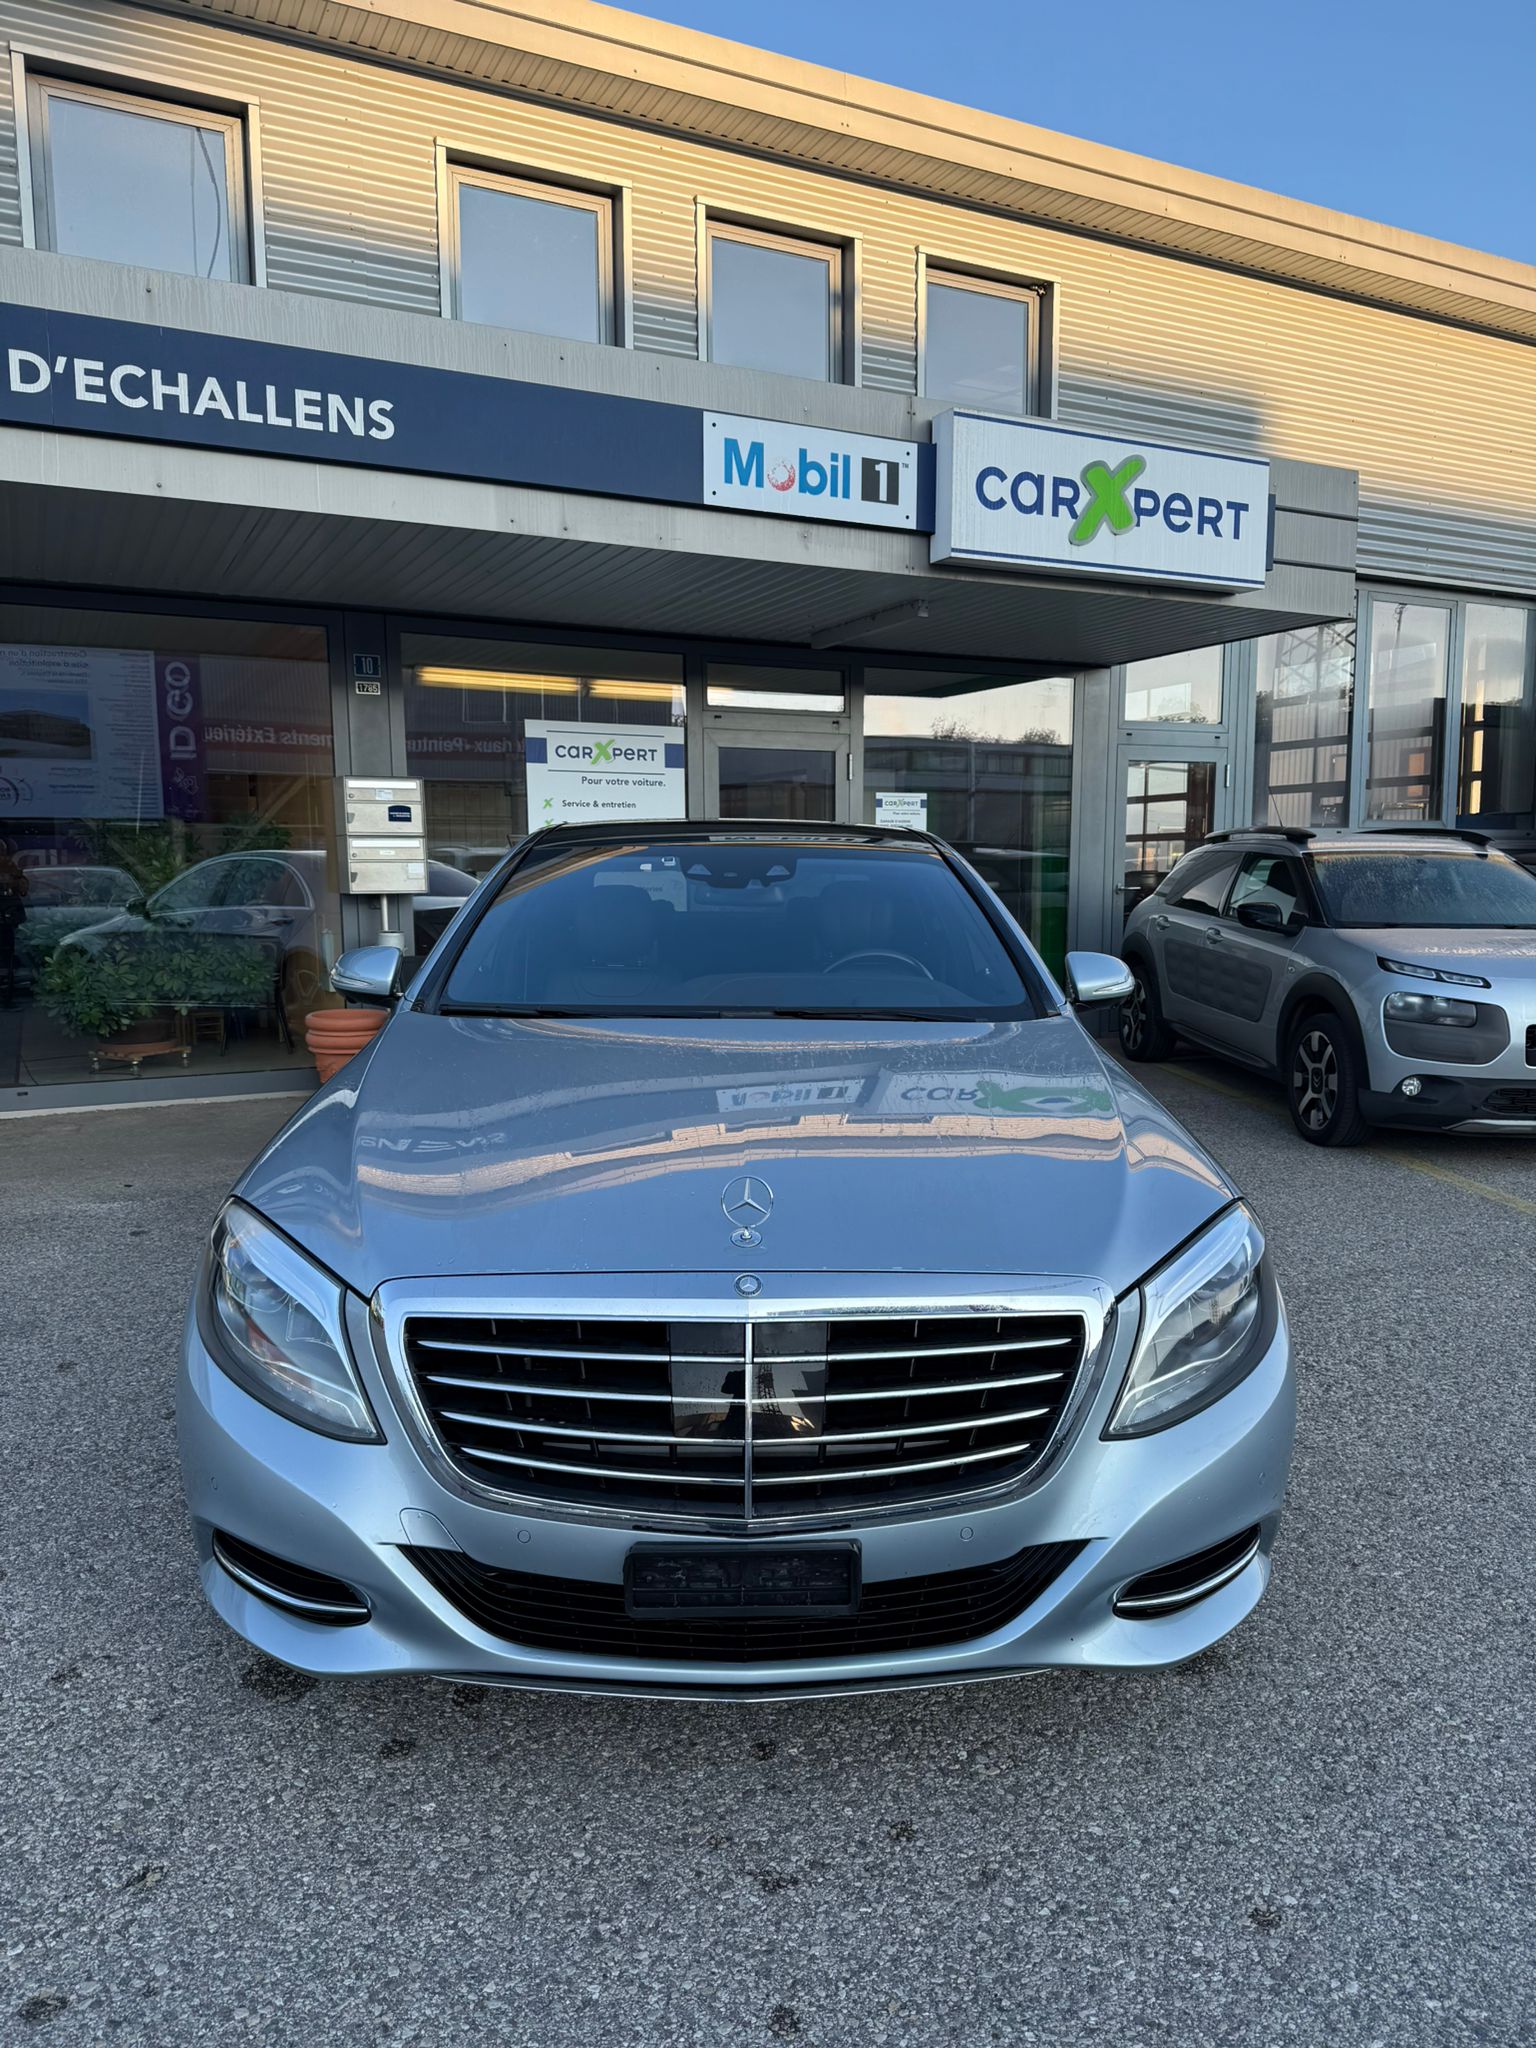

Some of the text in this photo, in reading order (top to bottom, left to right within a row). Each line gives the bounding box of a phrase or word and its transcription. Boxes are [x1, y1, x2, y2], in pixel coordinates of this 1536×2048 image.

[8, 347, 395, 440] D'ECHALLENS
[723, 437, 851, 499] Mobil
[361, 657, 373, 674] 10
[359, 683, 378, 692] 1785
[581, 776, 666, 787] Pour votre voiture.
[562, 800, 636, 809] Service & entretien
